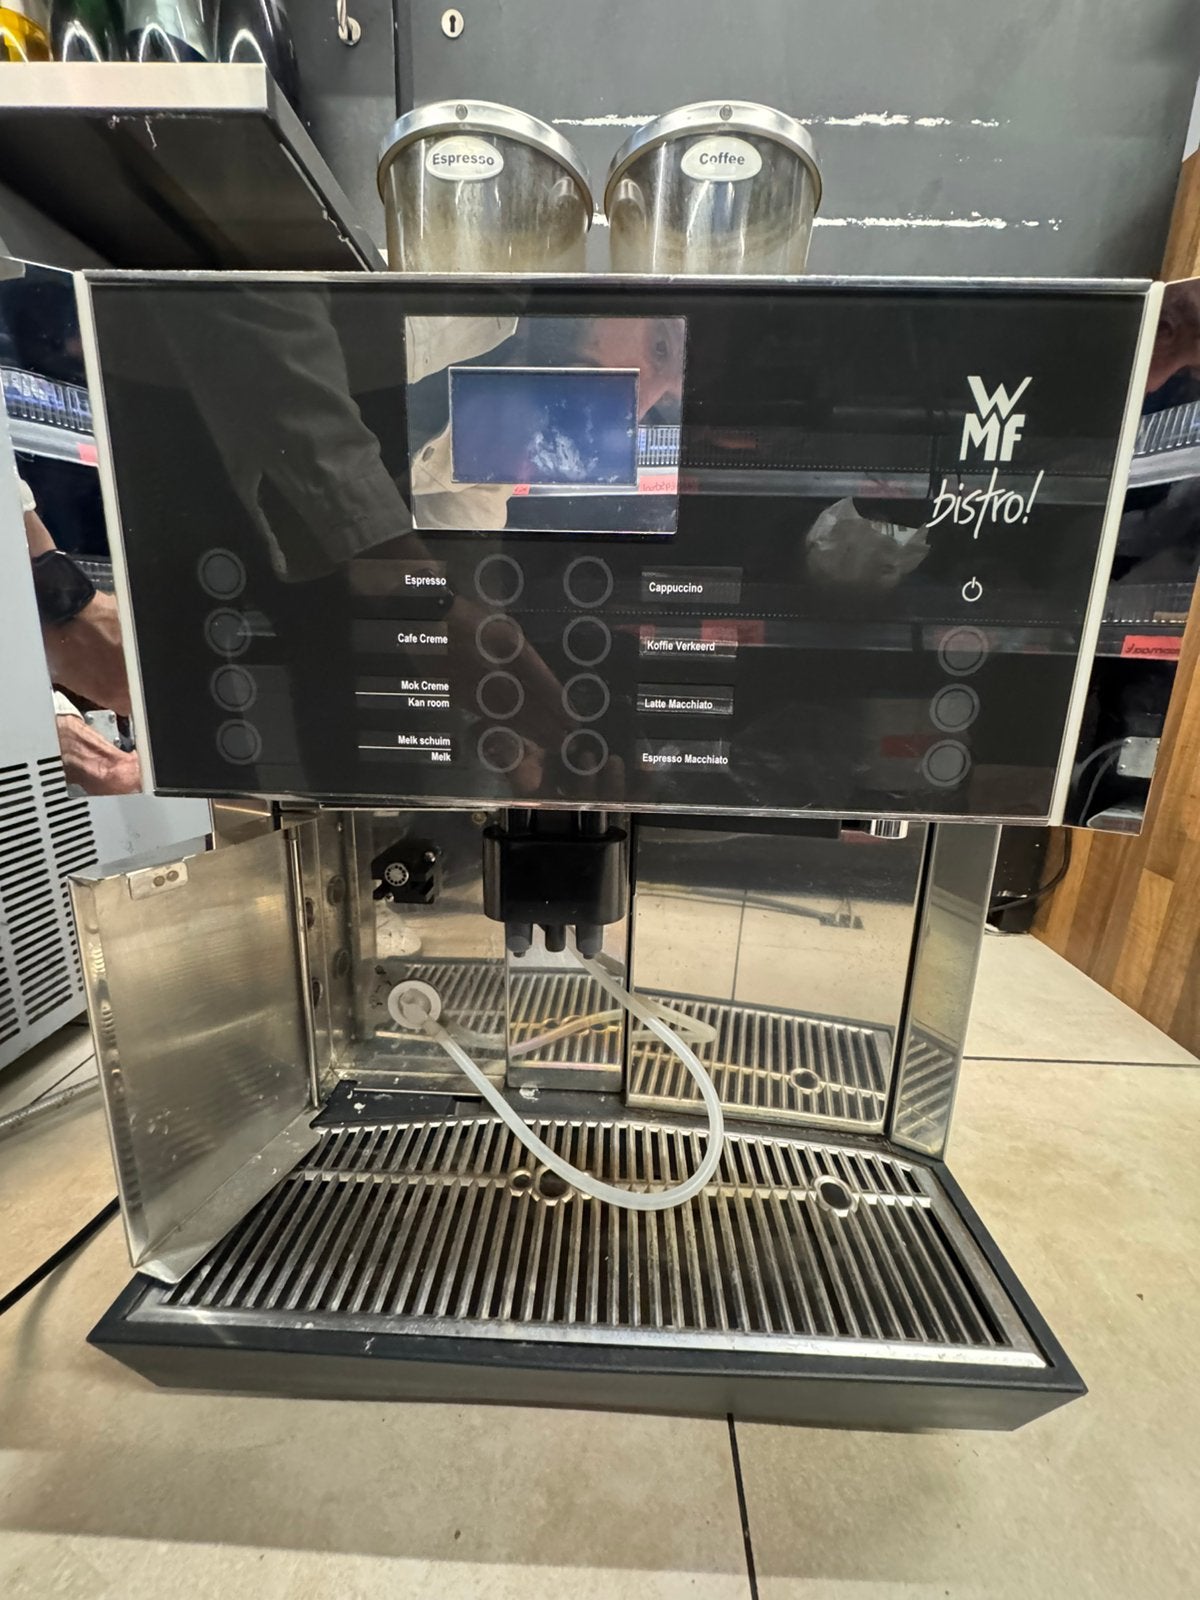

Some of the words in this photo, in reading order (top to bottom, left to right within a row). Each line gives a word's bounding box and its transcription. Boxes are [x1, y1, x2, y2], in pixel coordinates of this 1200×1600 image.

[432, 152, 495, 167] Espresso
[699, 151, 745, 166] Coffee
[959, 375, 1033, 461] WMF
[925, 467, 1045, 539] bistro!
[404, 574, 447, 588] Espresso
[648, 581, 704, 595] Cappuccino
[397, 632, 418, 644] Cafe
[419, 633, 449, 645] Creme
[646, 640, 674, 651] Koffie
[675, 640, 716, 652] Verkeerd
[400, 680, 420, 691] Mok
[421, 680, 450, 692] Creme
[407, 697, 426, 708] Kan
[426, 699, 451, 709] room
[644, 698, 667, 709] Latte
[668, 699, 714, 710] Macchiato
[397, 734, 419, 745] Melk
[419, 735, 452, 746] schuim
[430, 751, 453, 762] Melk
[642, 752, 683, 765] Espresso
[684, 753, 729, 765] Macchiato
